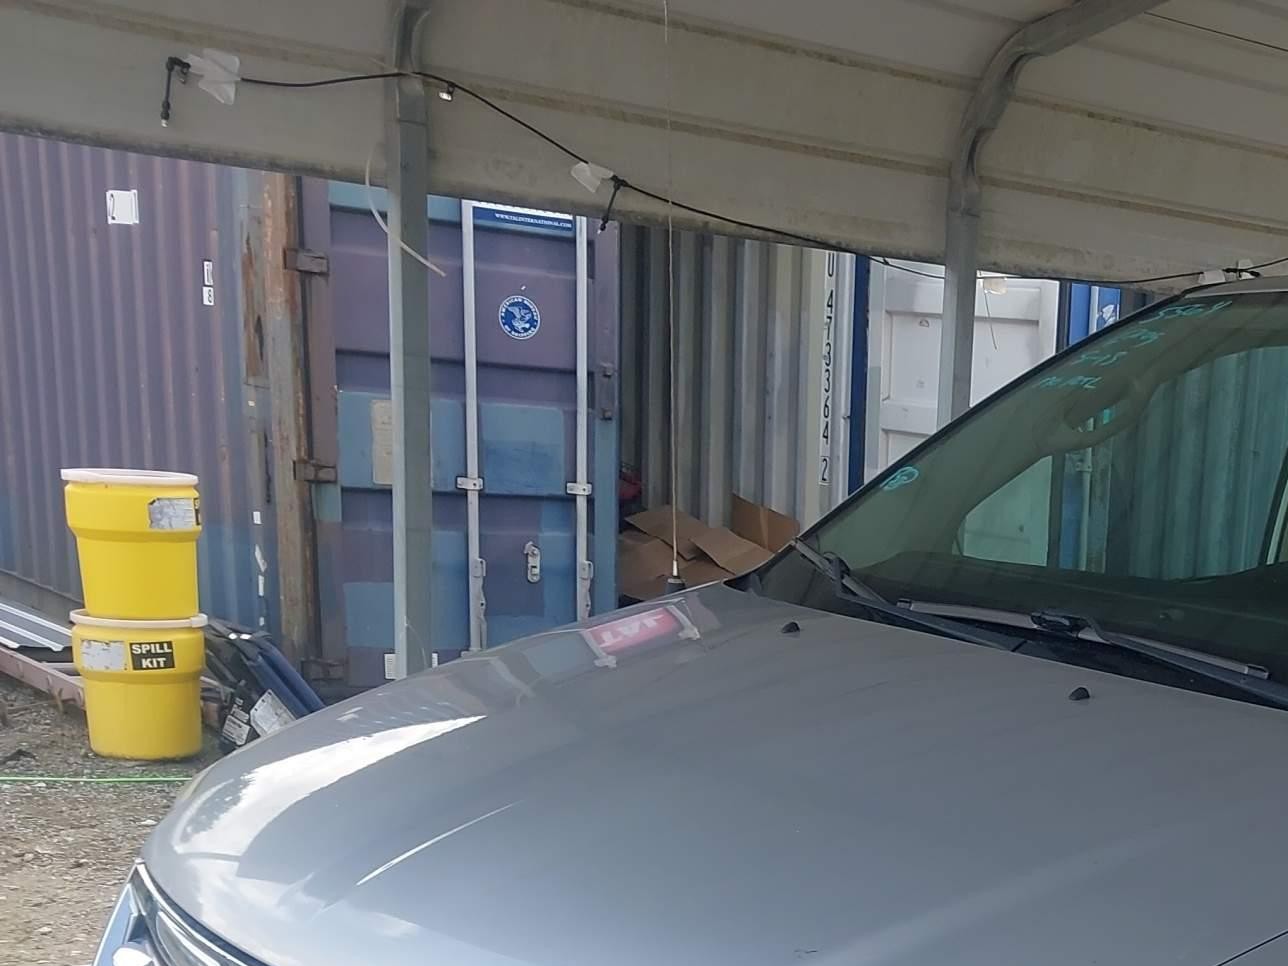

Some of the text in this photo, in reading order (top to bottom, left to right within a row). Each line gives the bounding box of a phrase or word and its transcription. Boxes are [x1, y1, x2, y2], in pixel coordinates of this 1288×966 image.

[822, 289, 834, 445] 473364
[820, 458, 829, 482] 2
[131, 642, 173, 655] SPILL
[141, 657, 166, 669] KIT
